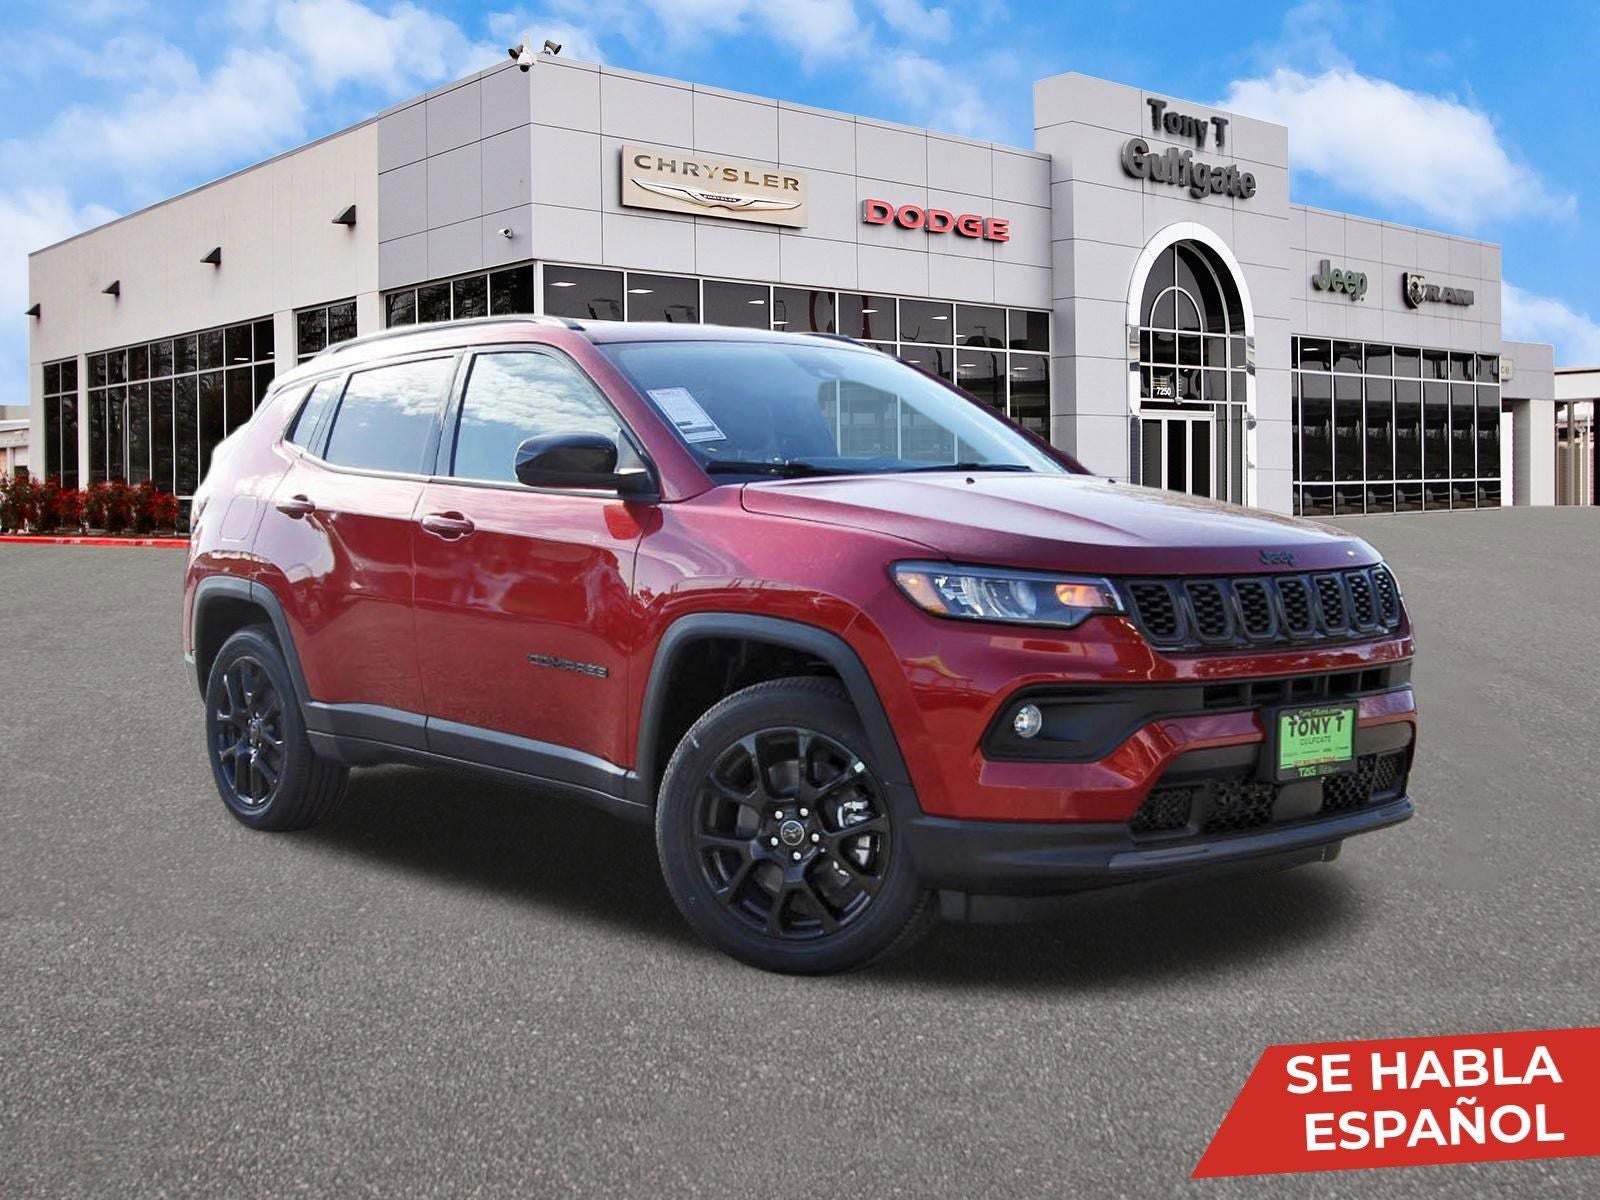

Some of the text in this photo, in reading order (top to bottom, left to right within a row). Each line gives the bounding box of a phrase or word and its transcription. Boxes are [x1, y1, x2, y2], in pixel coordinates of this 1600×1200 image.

[1146, 98, 1229, 147] Tony T
[633, 154, 800, 191] CHRYSLER
[1121, 138, 1257, 199] Gulfgate
[862, 198, 1010, 242] DODGE
[1312, 259, 1368, 301] Jeep
[1425, 284, 1475, 306] RAM
[1156, 386, 1172, 396] 7250
[1259, 549, 1294, 567] Jeep
[1288, 715, 1345, 738] TONY T
